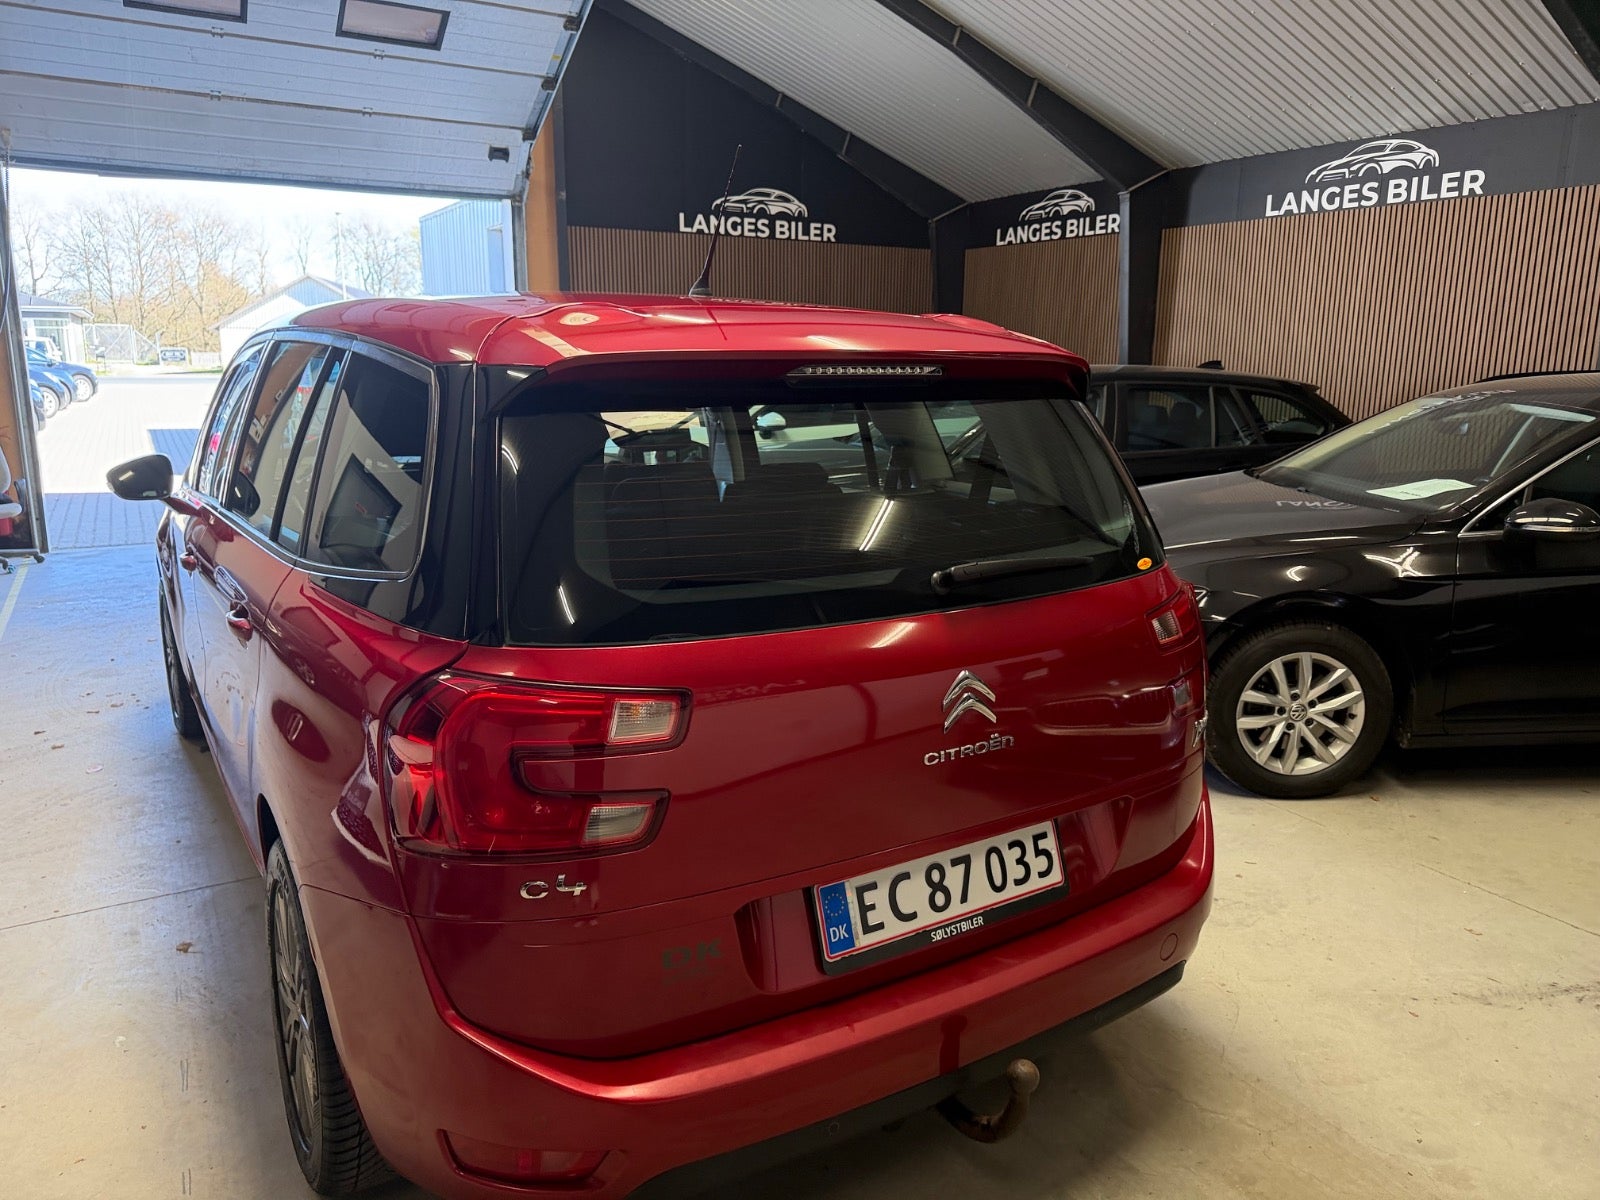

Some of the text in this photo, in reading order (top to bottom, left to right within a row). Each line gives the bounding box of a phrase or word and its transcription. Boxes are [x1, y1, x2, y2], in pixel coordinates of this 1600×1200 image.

[1265, 169, 1486, 217] LANGES BILER
[678, 212, 836, 242] LANGES BILER
[995, 213, 1120, 246] LANGES BILER
[519, 874, 587, 899] C4
[855, 831, 1054, 935] EC 87 035
[830, 926, 849, 943] DK
[930, 916, 984, 942] SØLYSTBILER
